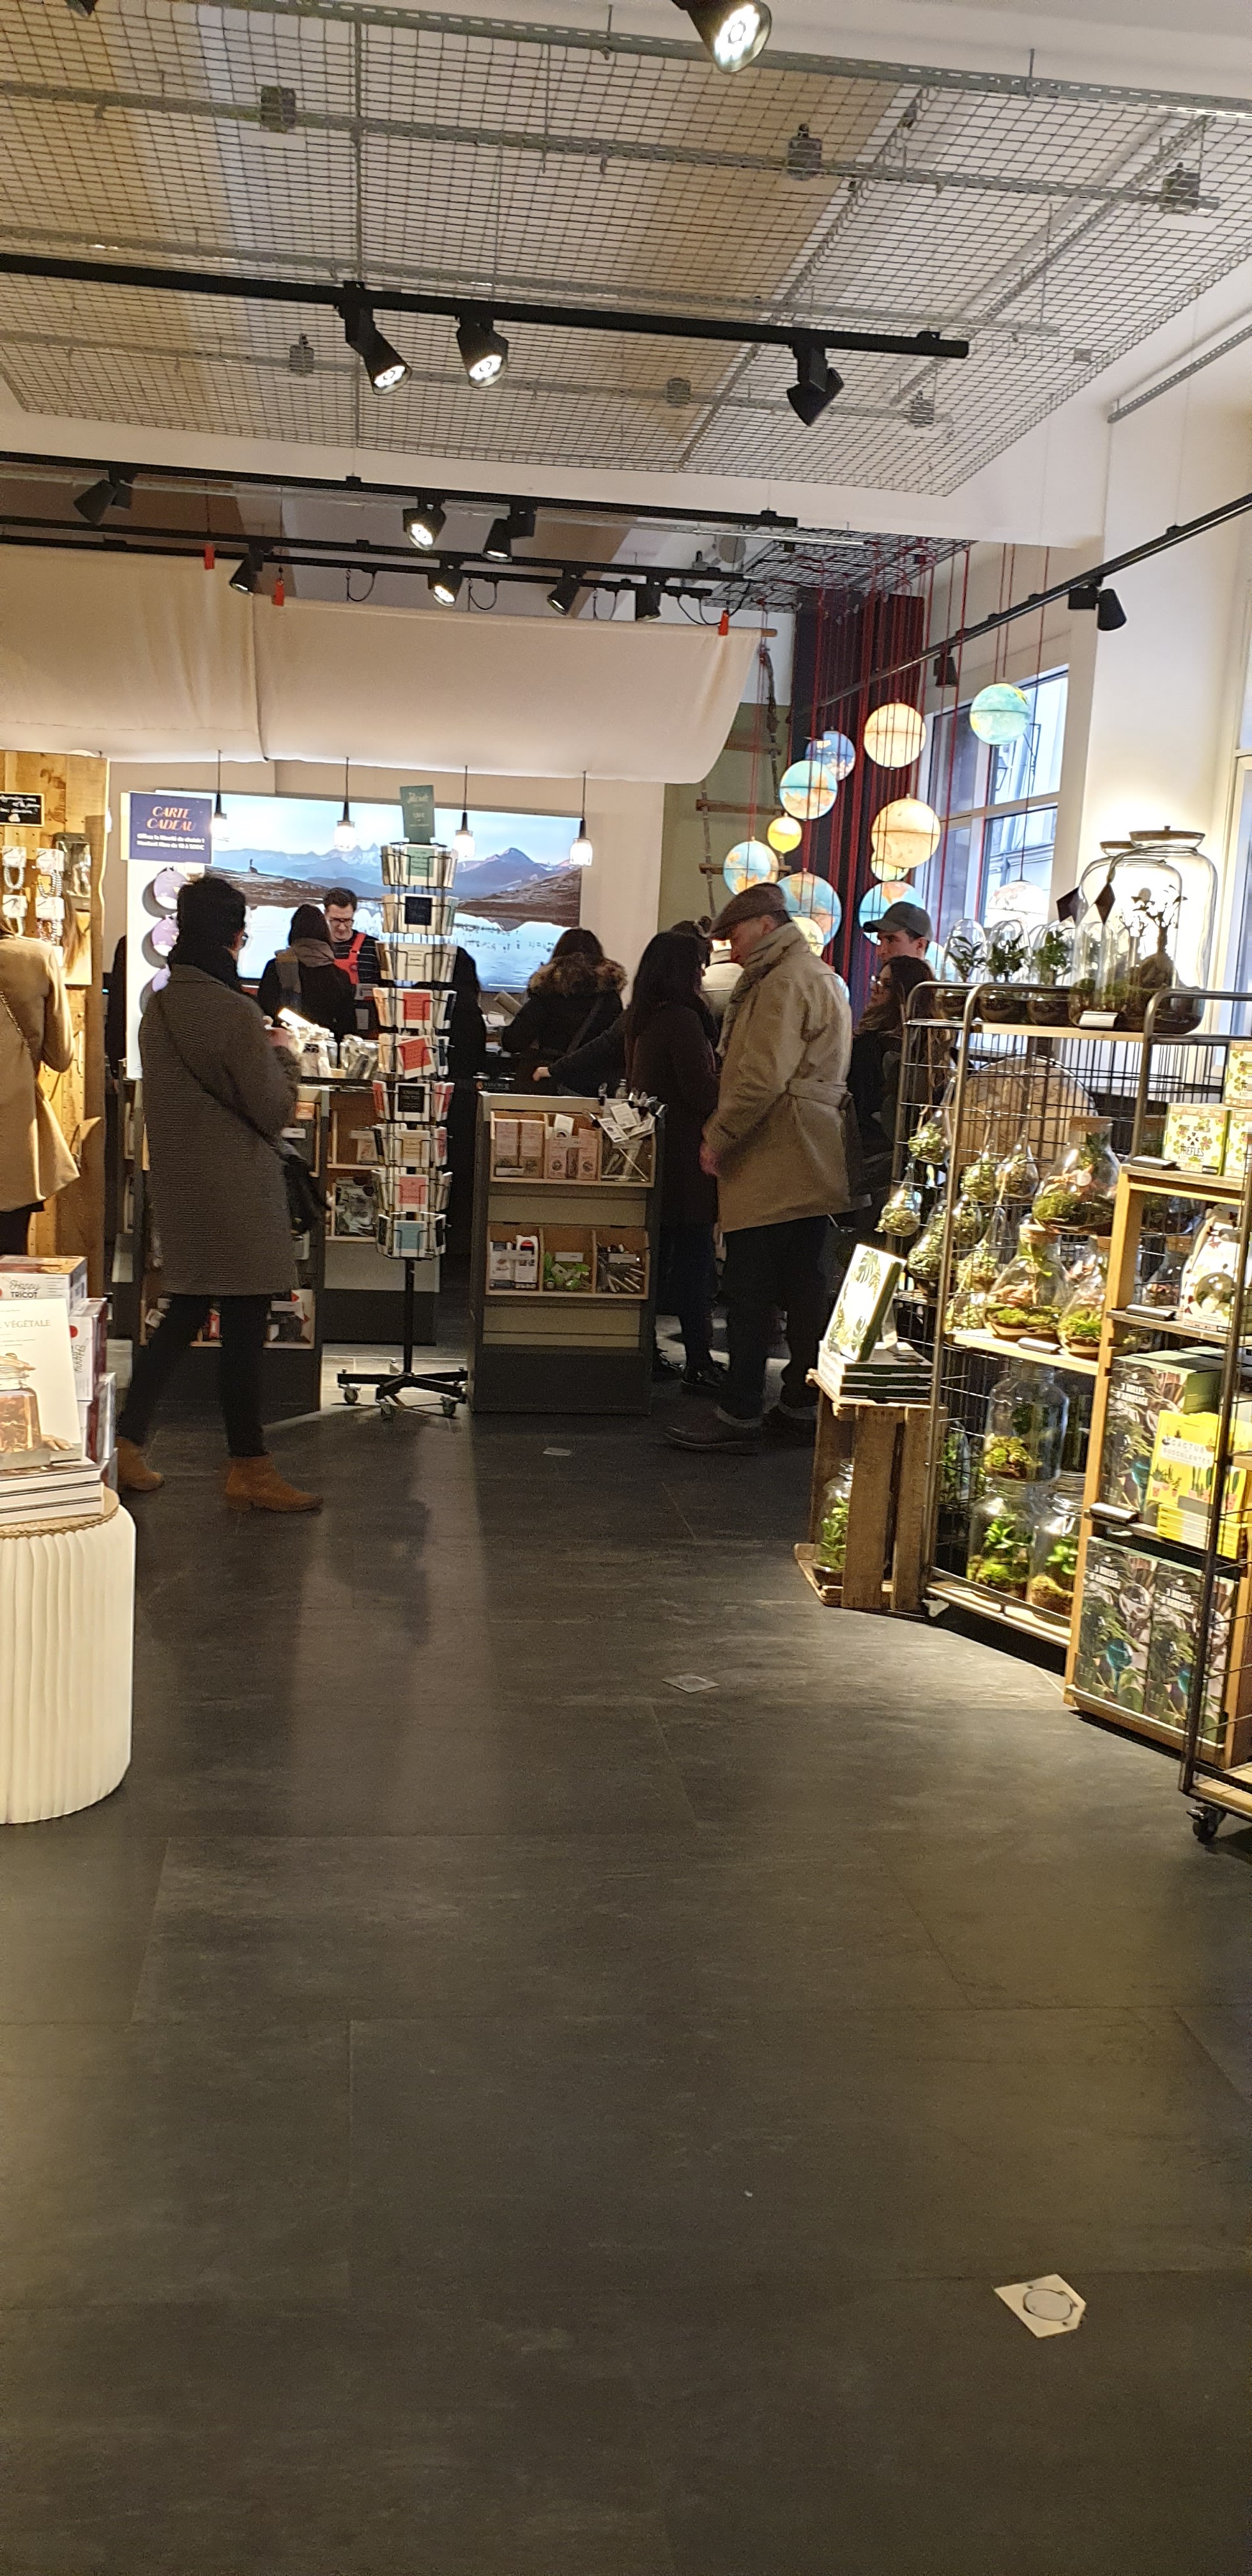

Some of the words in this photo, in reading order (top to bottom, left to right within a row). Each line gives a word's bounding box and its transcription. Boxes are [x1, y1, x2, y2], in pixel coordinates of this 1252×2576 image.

[152, 806, 192, 819] CARTE
[146, 818, 197, 831] CADEAU
[10, 1280, 41, 1291] Happy
[4, 1319, 51, 1328] VÉGÉTALE
[1172, 1439, 1205, 1453] CACTUS
